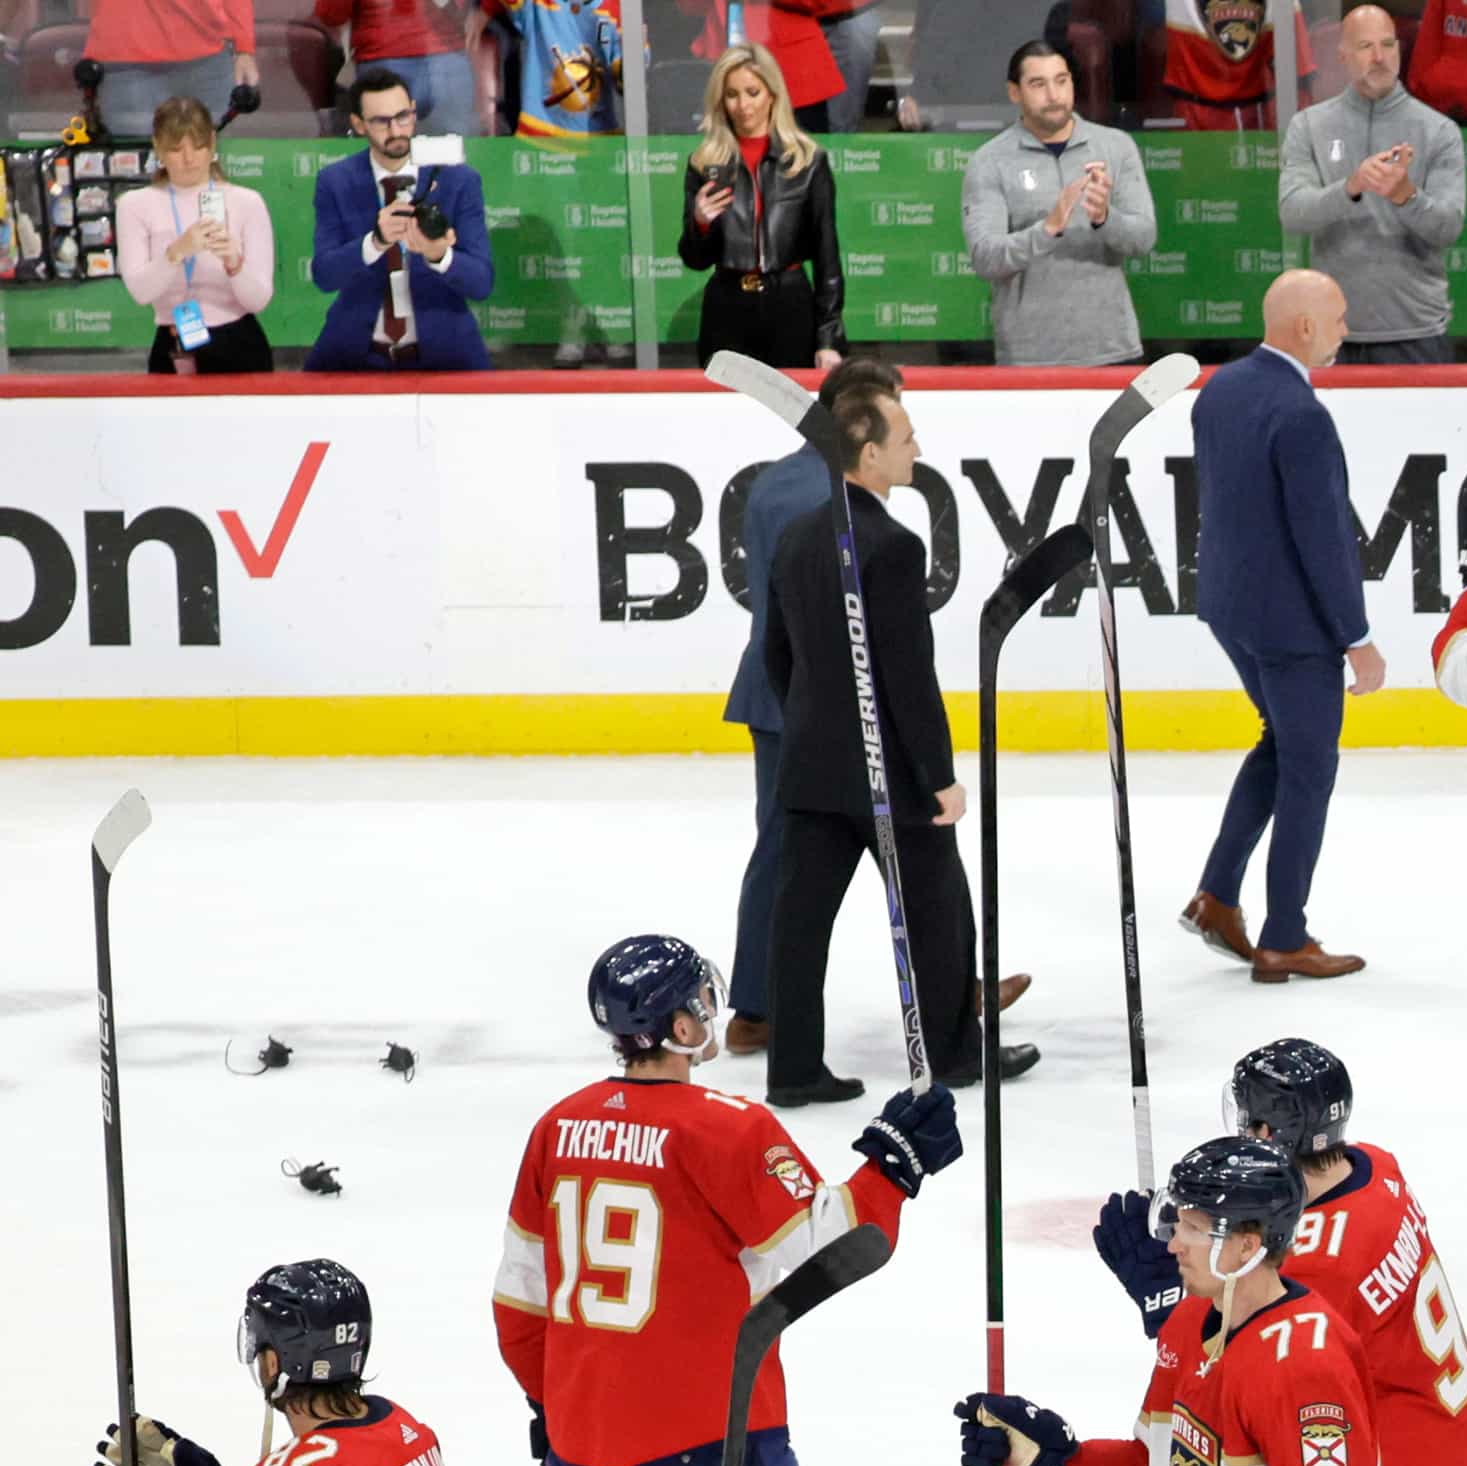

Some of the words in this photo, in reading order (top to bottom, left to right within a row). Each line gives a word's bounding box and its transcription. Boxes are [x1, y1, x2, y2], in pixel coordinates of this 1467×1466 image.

[845, 591, 886, 793] SHERWOOD
[1329, 1101, 1347, 1121] 91
[556, 1118, 670, 1169] TKACHUK
[547, 1174, 664, 1334] 19
[1294, 1209, 1348, 1257] 91
[334, 1322, 360, 1345] 82
[1260, 1311, 1330, 1362] 77
